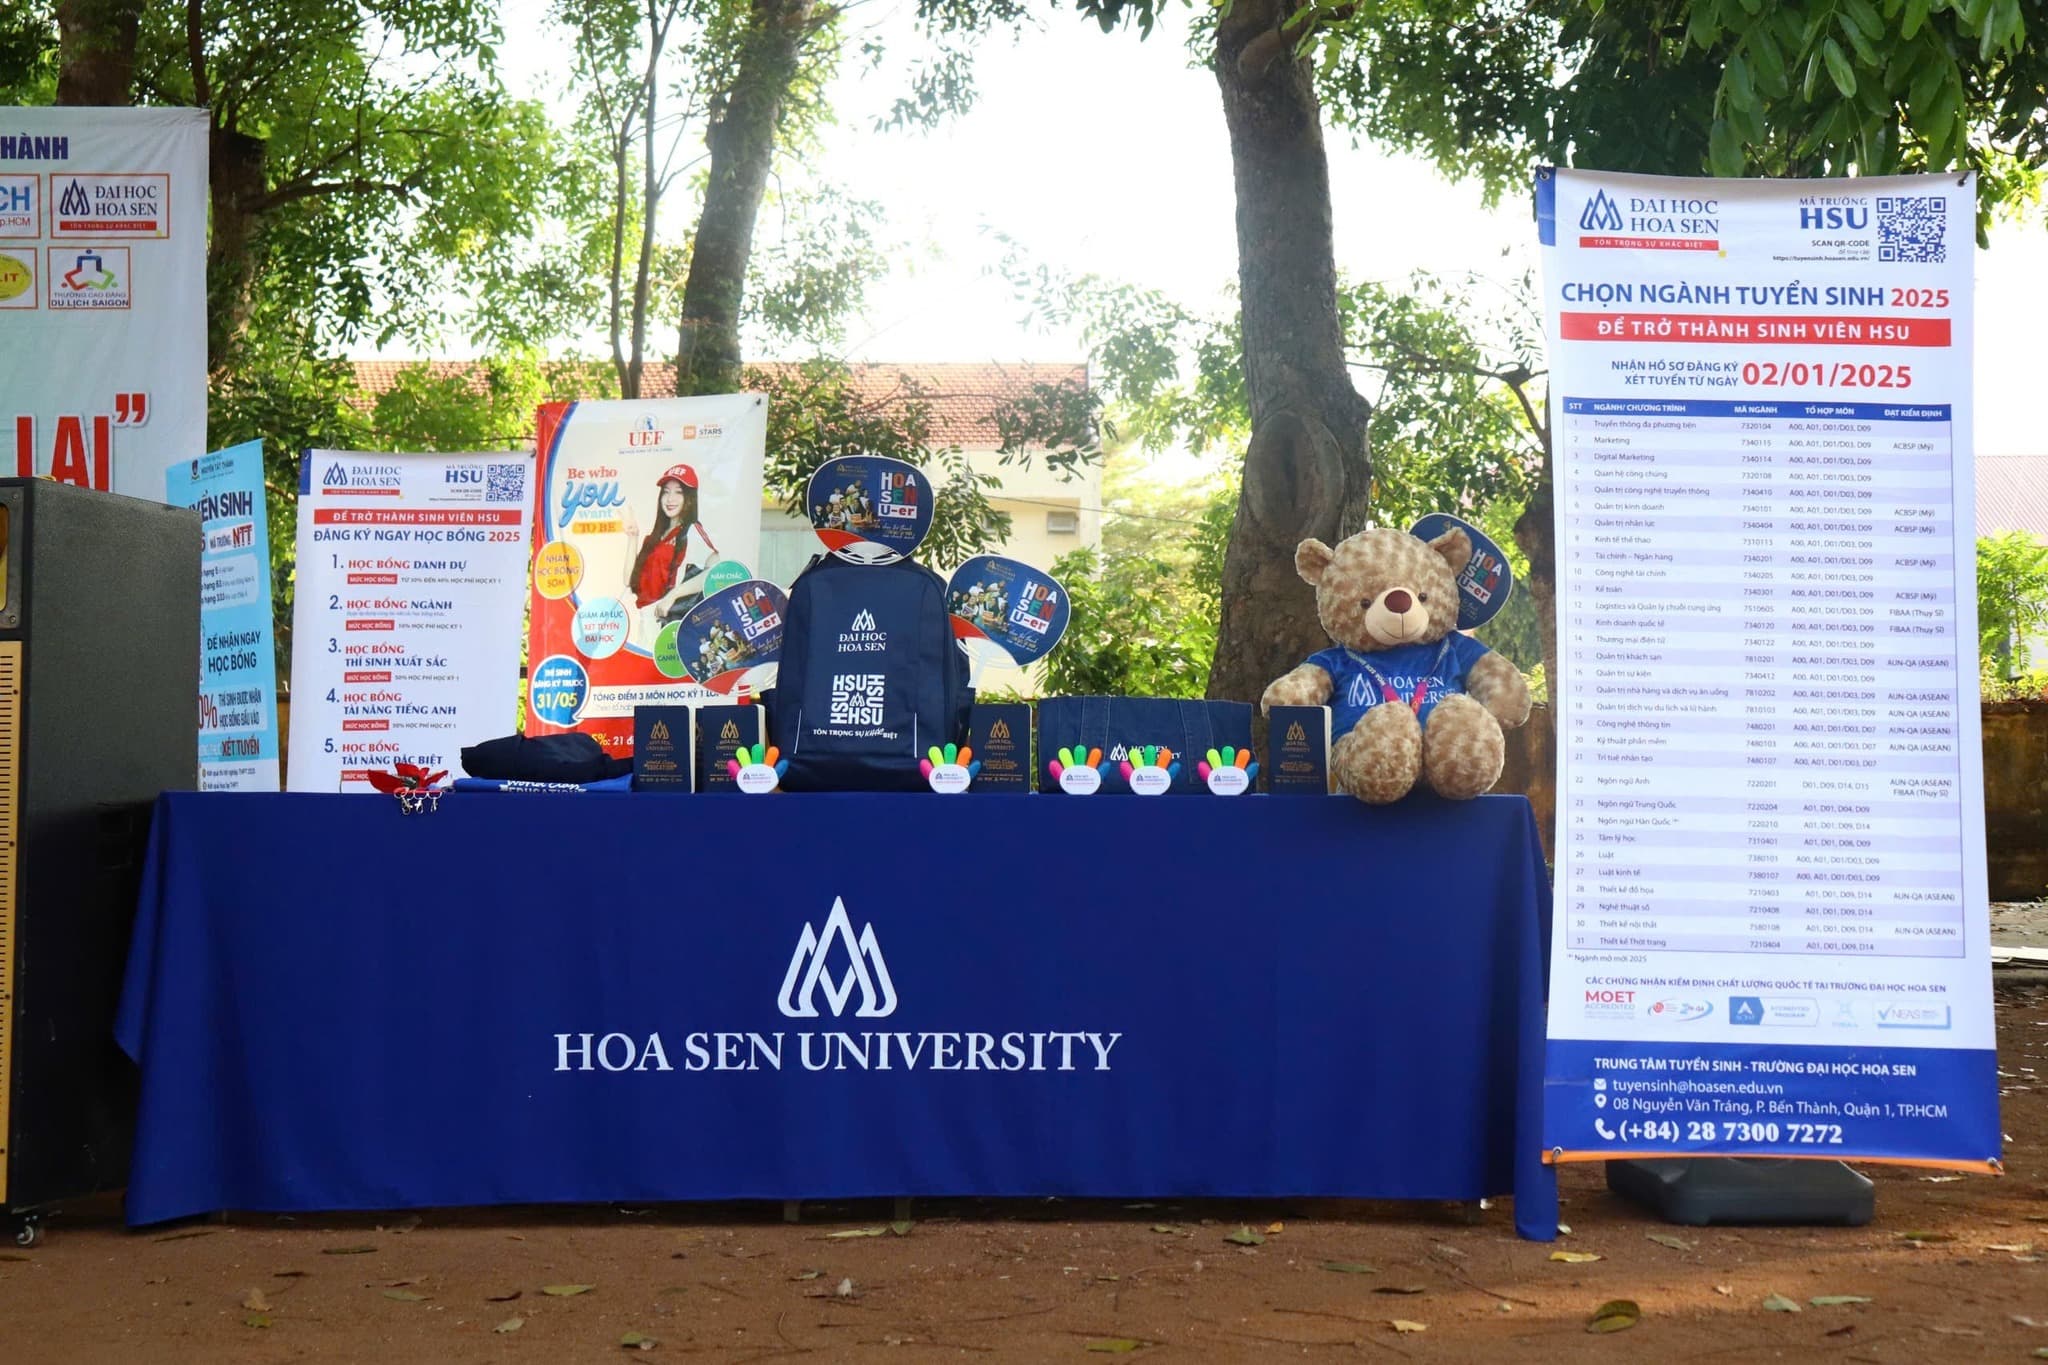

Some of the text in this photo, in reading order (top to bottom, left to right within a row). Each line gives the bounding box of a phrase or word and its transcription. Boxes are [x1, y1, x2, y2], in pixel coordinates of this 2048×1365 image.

[130, 202, 157, 216] SEN
[1630, 218, 1719, 234] HOA SEN
[1800, 207, 1868, 229] HSU
[1561, 280, 1949, 308] CHỌN NGÀNH TUYỂN SINH 2025
[1598, 316, 1910, 340] ĐỂ TRỞ THÀNH SINH VIÊN HSU
[1625, 375, 1646, 385] XÉT
[1707, 376, 1739, 387] NGÀY
[1742, 362, 1912, 388] 02/01/2025
[629, 430, 664, 447] UEF
[699, 428, 722, 439] STARS
[1594, 436, 1630, 445] Marketing
[1594, 453, 1655, 462] Digital Marketing
[567, 466, 617, 480] Be who
[881, 472, 916, 490] HOA
[220, 491, 253, 518] SINH
[559, 481, 626, 528] you
[881, 504, 915, 517] U-er
[376, 511, 415, 522] THÀNH
[418, 512, 445, 522] SINH
[448, 512, 474, 523] VIÊN
[478, 513, 501, 523] HSU
[580, 522, 616, 533] TO BE
[314, 528, 350, 541] ĐĂNG
[374, 530, 411, 541] NGAY
[414, 530, 443, 544] HỌC
[489, 531, 520, 542] 2025
[1022, 580, 1058, 604] HOA
[329, 595, 343, 610] 2.
[410, 599, 453, 610] NGÀNH
[1017, 598, 1056, 622] SEN
[1013, 611, 1046, 630] U-er
[328, 638, 341, 653] 3.
[838, 641, 886, 653] HOA SEN
[365, 658, 391, 667] SINH
[833, 674, 867, 691] HSU
[326, 688, 340, 703] 4.
[639, 692, 643, 700] 3
[866, 675, 885, 707] HSU
[537, 691, 578, 710] 31/05
[830, 692, 850, 724] HSU
[431, 706, 456, 715] ANH
[848, 707, 884, 725] HSU
[324, 738, 338, 753] 5.
[1585, 990, 1636, 1003] MOET
[553, 1032, 1123, 1073] HOA SEN UNIVERSITY
[1594, 1057, 1917, 1077] TRUNG TÂM TUYỂN SINH TRƯỜNG ĐẠI HỌC HOA SEN
[1612, 1080, 1784, 1095] tuyensinh@hoasen.edu.vn
[1612, 1098, 1629, 1110] 08
[1633, 1097, 1683, 1113] Nguyễn
[1685, 1098, 1710, 1112] Văn
[1711, 1098, 1753, 1116] Tráng,
[1756, 1101, 1765, 1113] P.
[1769, 1099, 1794, 1114] Bến
[1796, 1101, 1841, 1117] Thành,
[1884, 1104, 1895, 1118] 1,
[1897, 1103, 1948, 1118] TP.HCM
[1619, 1119, 1843, 1143] (+84) 28 7300 7272
